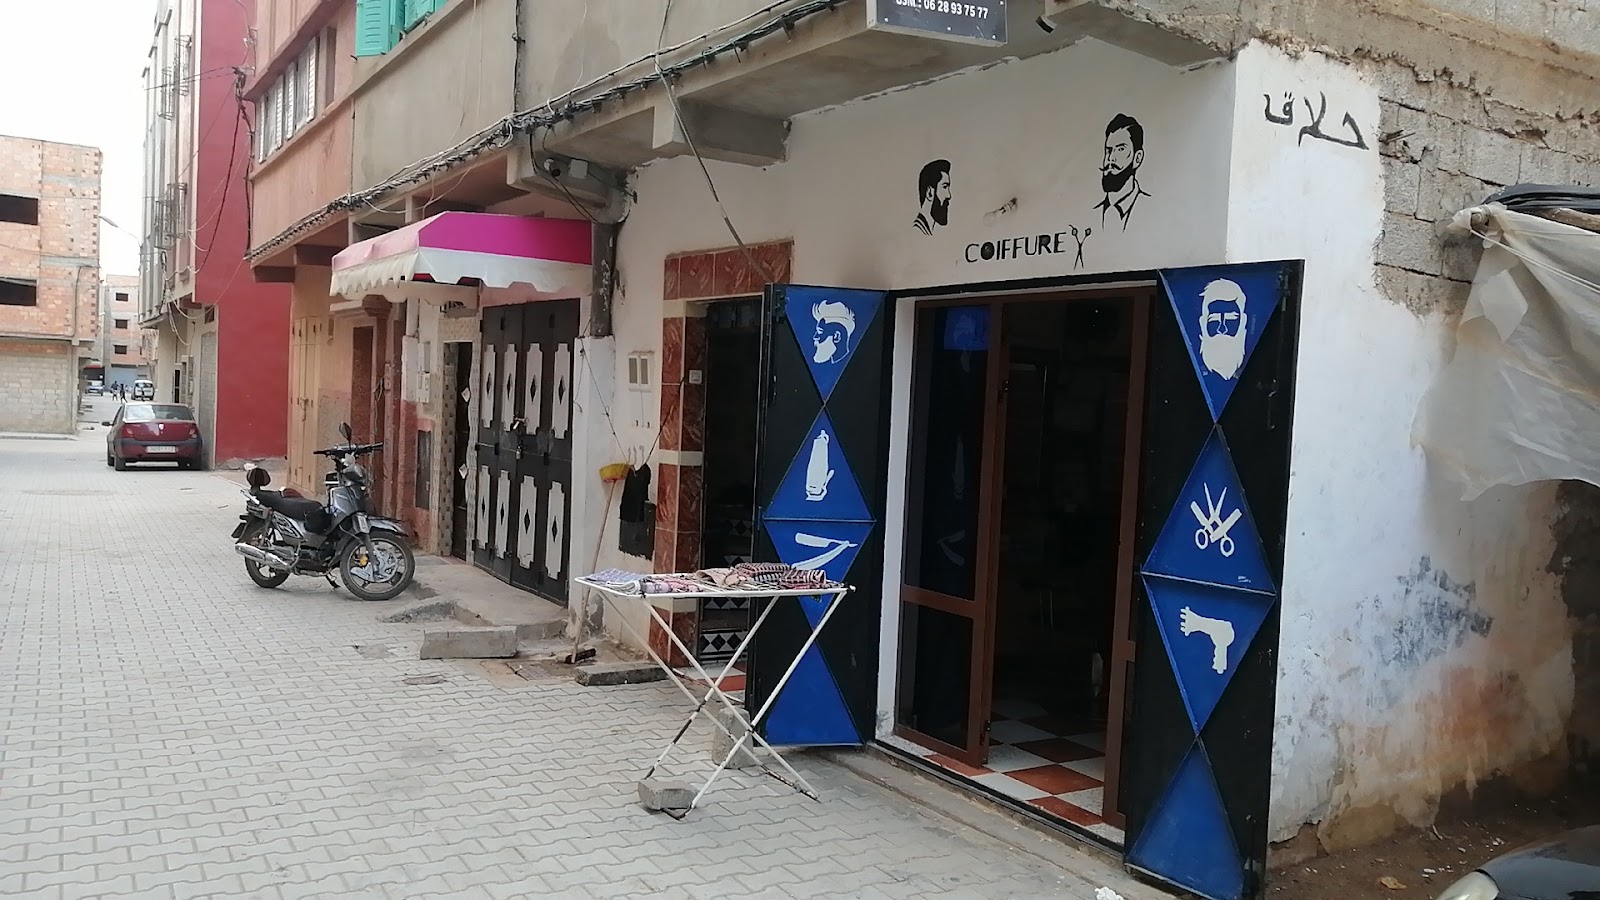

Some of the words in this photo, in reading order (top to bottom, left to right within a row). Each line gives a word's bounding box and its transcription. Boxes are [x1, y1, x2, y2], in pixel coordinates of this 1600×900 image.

[923, 0, 936, 10] 06
[937, 1, 950, 13] 28
[950, 2, 963, 15] 93
[964, 4, 976, 18] 75
[977, 7, 989, 19] 77
[1262, 90, 1370, 151] حلاق
[965, 231, 1067, 263] COIFFURE
